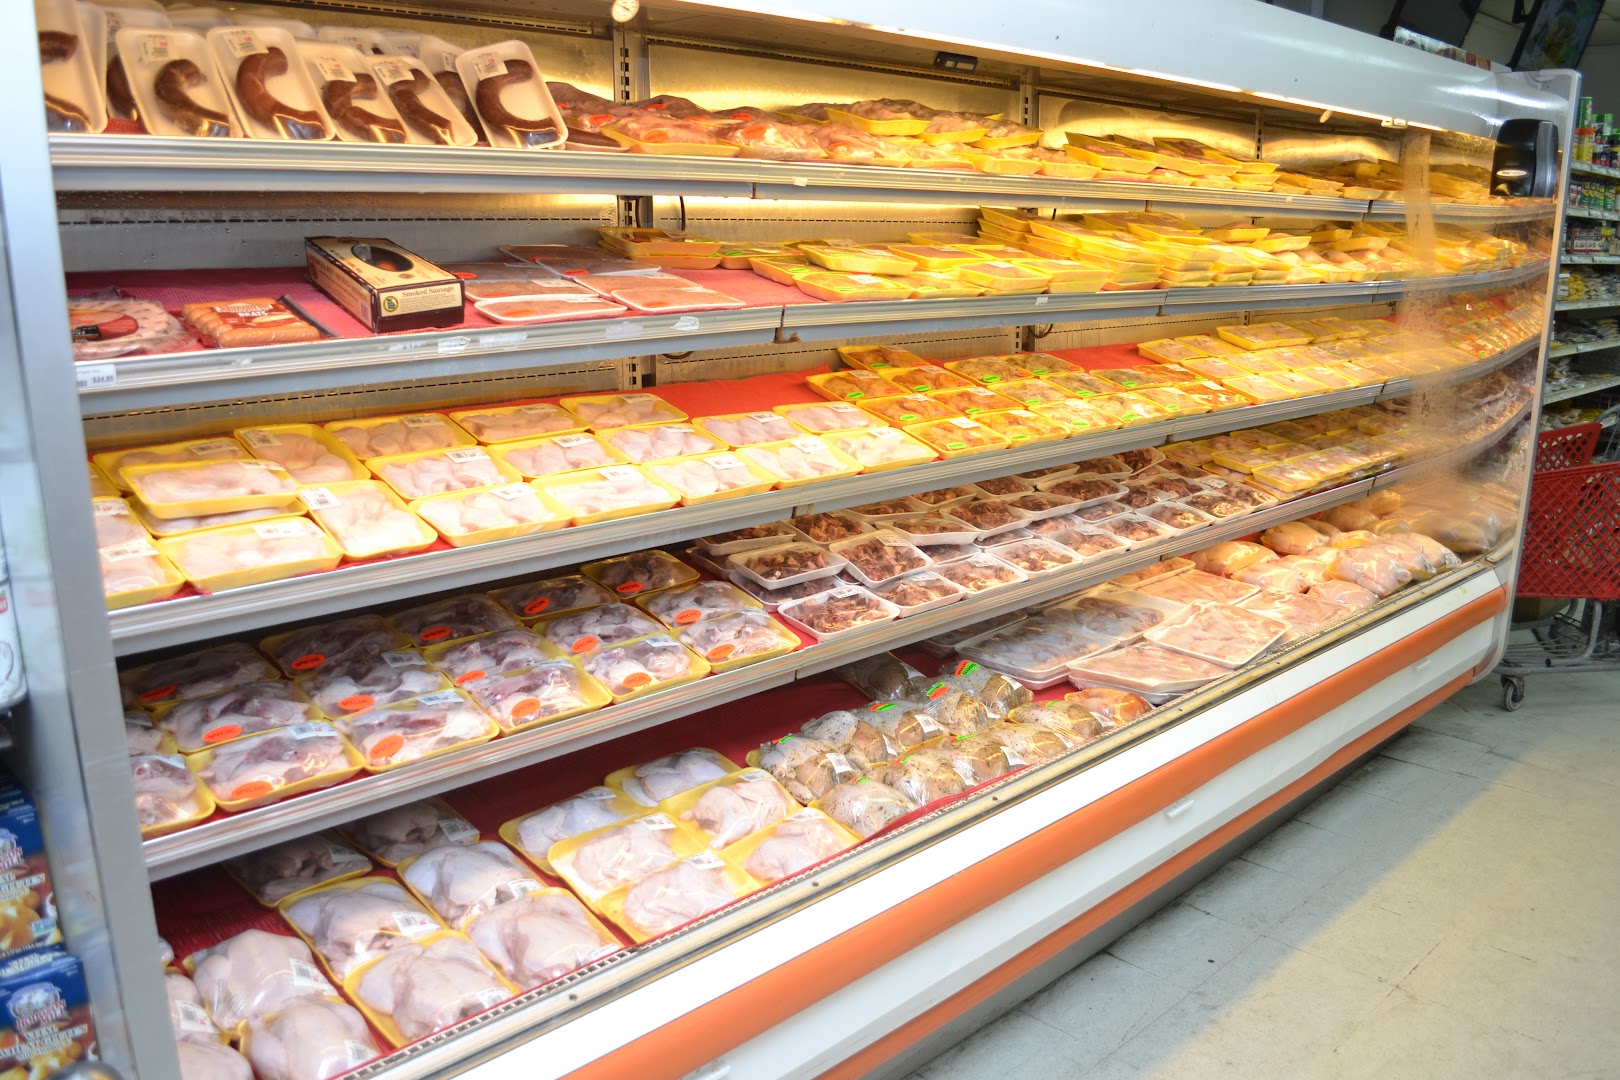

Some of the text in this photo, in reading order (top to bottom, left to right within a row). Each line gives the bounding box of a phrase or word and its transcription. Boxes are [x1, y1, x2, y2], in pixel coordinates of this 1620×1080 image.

[402, 286, 455, 298] Smoked Sausage
[619, 583, 639, 592] SPECIAL
[527, 598, 547, 612] SPECIAL
[678, 611, 699, 622] SPECIAL
[423, 627, 448, 638] SPECIAL
[574, 638, 595, 651] SPECIAL
[712, 645, 732, 657] SPECIAL
[295, 656, 321, 667] SPECIAL
[626, 675, 647, 686] SPECIAL
[342, 698, 369, 707] SPECIAL
[513, 701, 537, 715] SPECIAL
[208, 727, 238, 740] SPECIAL
[373, 739, 401, 756] SPECIAL
[236, 784, 268, 796] SPECIAL
